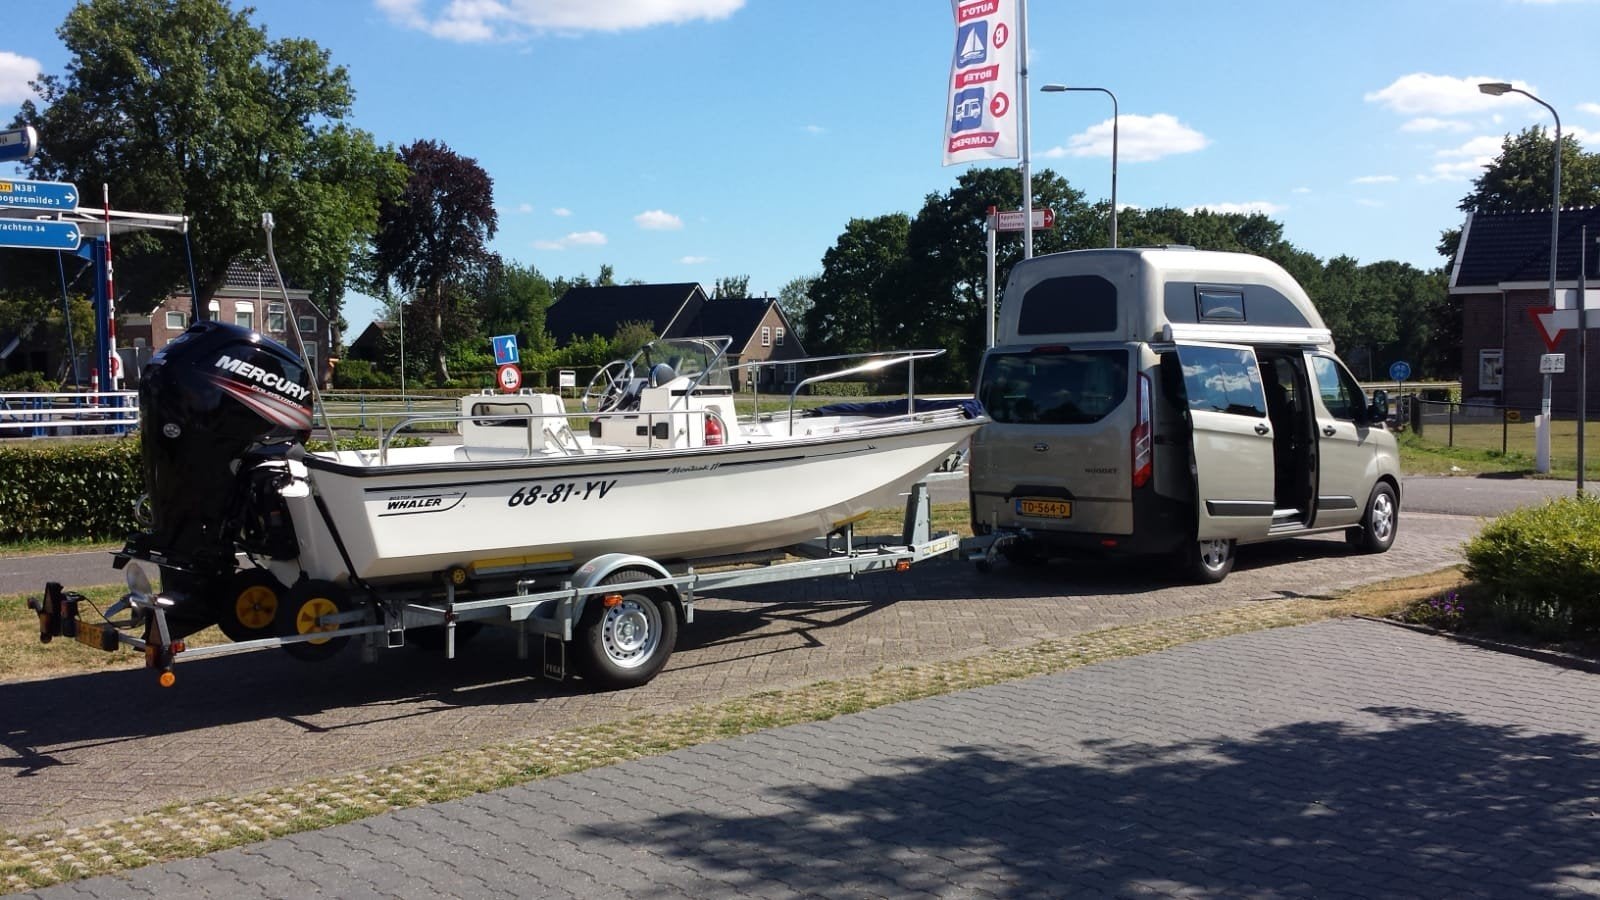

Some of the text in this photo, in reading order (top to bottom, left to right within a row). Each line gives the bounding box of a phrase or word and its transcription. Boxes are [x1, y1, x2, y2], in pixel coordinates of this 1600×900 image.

[14, 183, 37, 193] N381
[35, 225, 46, 233] 34
[214, 355, 311, 401] MERCURY
[507, 479, 618, 508] 68-81-YV
[387, 498, 442, 510] WHALER
[1022, 501, 1067, 514] TD-564-D
